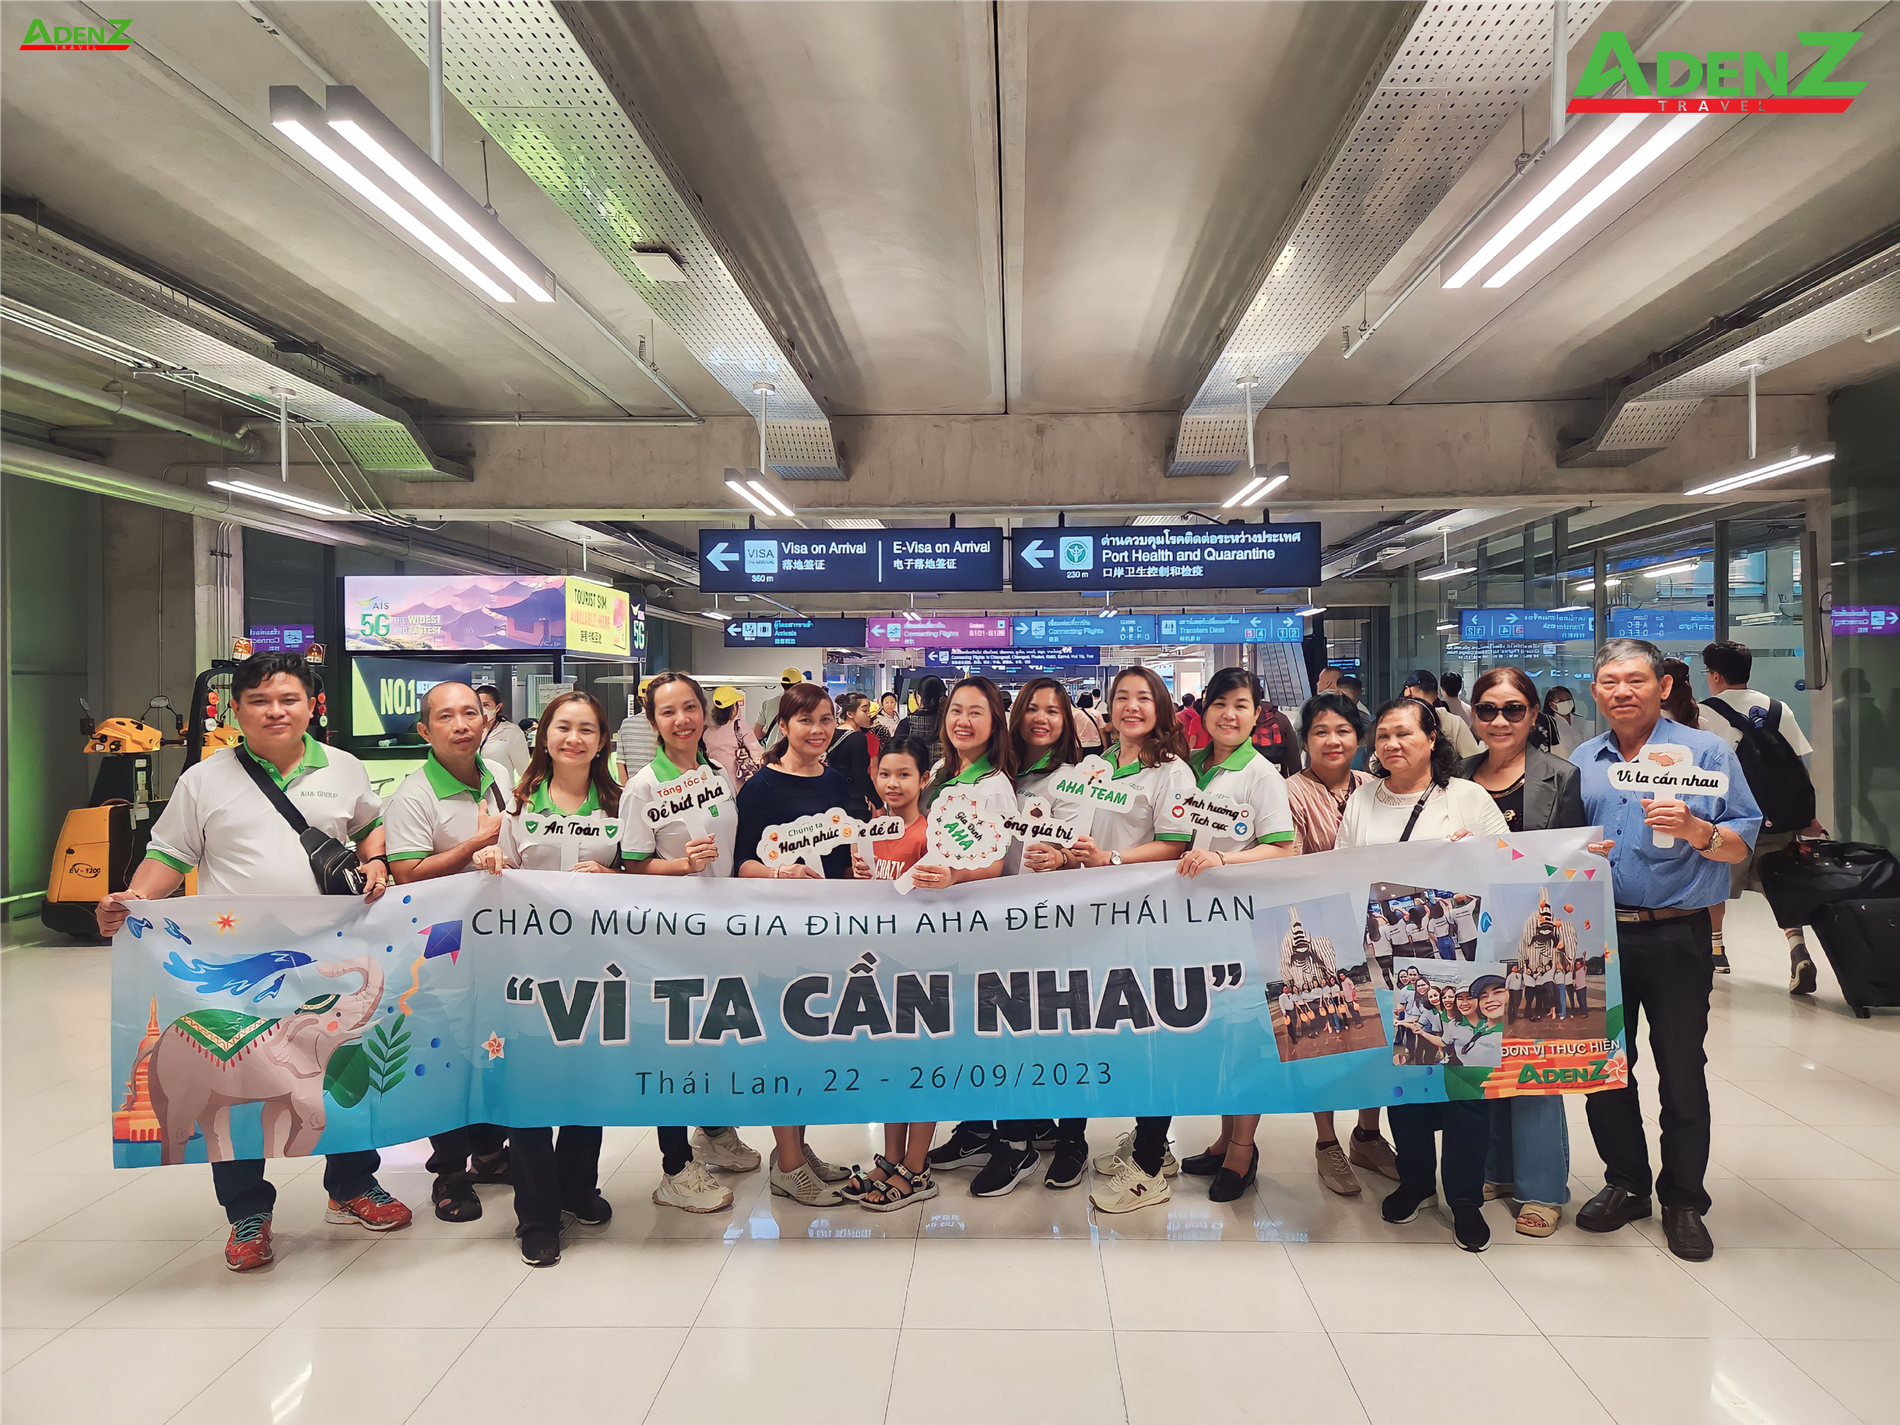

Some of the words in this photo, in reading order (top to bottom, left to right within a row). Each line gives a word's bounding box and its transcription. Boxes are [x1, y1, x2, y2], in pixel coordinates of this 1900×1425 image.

[748, 549, 774, 558] VISA
[782, 542, 808, 554] Visa
[811, 544, 826, 554] on
[829, 542, 866, 554] Arrival
[894, 542, 932, 553] E-Visa
[935, 543, 950, 553] on
[953, 540, 990, 553] Arrival
[1102, 550, 1129, 562] Port
[1132, 548, 1174, 562] Health
[1176, 548, 1201, 561] and
[1204, 547, 1276, 560] Quarantine
[360, 614, 390, 636] 5G
[408, 615, 442, 624] WIDEST
[634, 620, 644, 650] 5G
[380, 678, 416, 715] NO.1
[1681, 774, 1718, 788] nhau
[697, 782, 724, 808] phá
[1056, 780, 1084, 795] AHA
[1090, 786, 1128, 805] TEAM
[543, 821, 563, 835] An
[812, 828, 839, 847] phúc
[887, 822, 899, 834] đi
[944, 822, 974, 851] AHA
[1001, 814, 1028, 835] ống
[1031, 824, 1053, 837] giá
[1056, 824, 1074, 843] trị
[876, 858, 904, 880] CRAZY
[472, 903, 572, 936] CHÀO
[591, 906, 706, 936] MỪNG
[726, 914, 788, 936] GIA
[805, 911, 896, 936] ĐÌNH
[916, 910, 988, 933] AHA
[1005, 900, 1074, 930] ĐẾN
[1090, 895, 1168, 926] THÁI
[1188, 895, 1255, 923] LAN
[654, 976, 762, 1040] TA
[782, 952, 950, 1036] CẦN
[636, 1071, 710, 1096] Thái
[732, 1070, 802, 1096] Lan,
[824, 1069, 860, 1092] 22
[910, 1062, 1112, 1089] 26/09/2023
